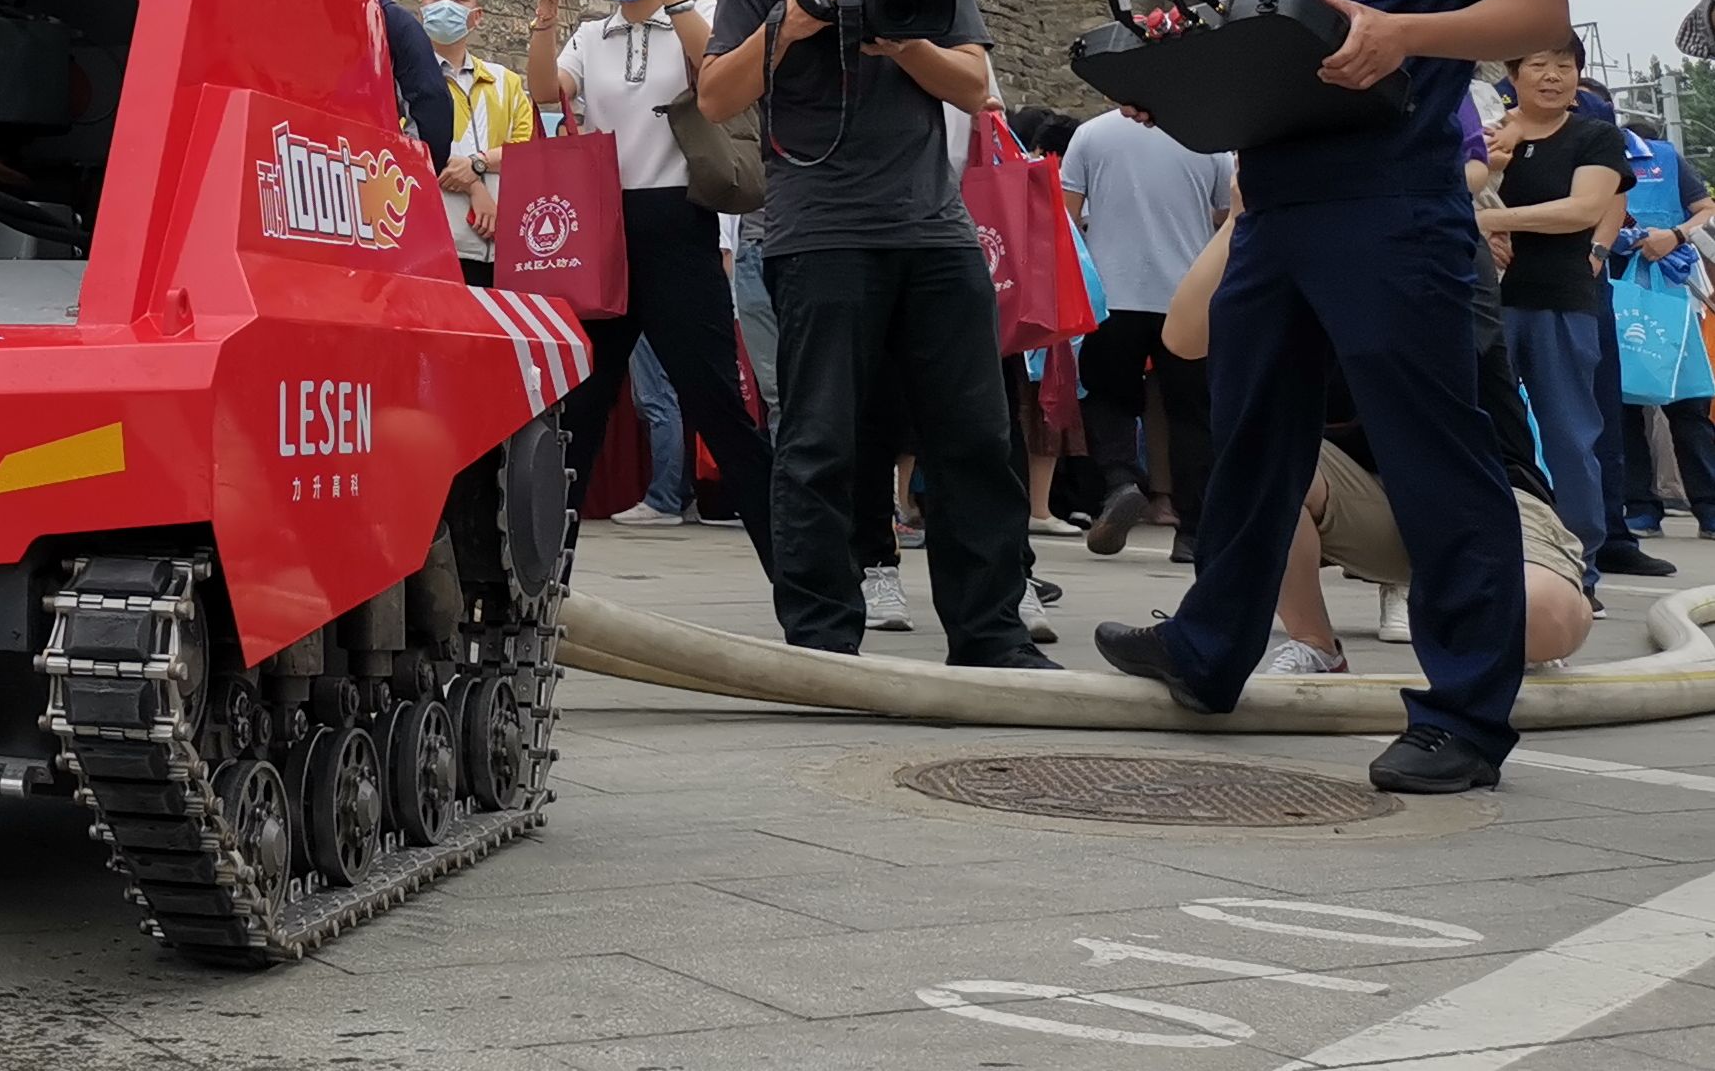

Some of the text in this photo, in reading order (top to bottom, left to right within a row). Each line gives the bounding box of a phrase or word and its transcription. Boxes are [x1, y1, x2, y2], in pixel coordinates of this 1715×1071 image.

[279, 379, 372, 457] LESEN
[292, 473, 359, 502] 力升高科
